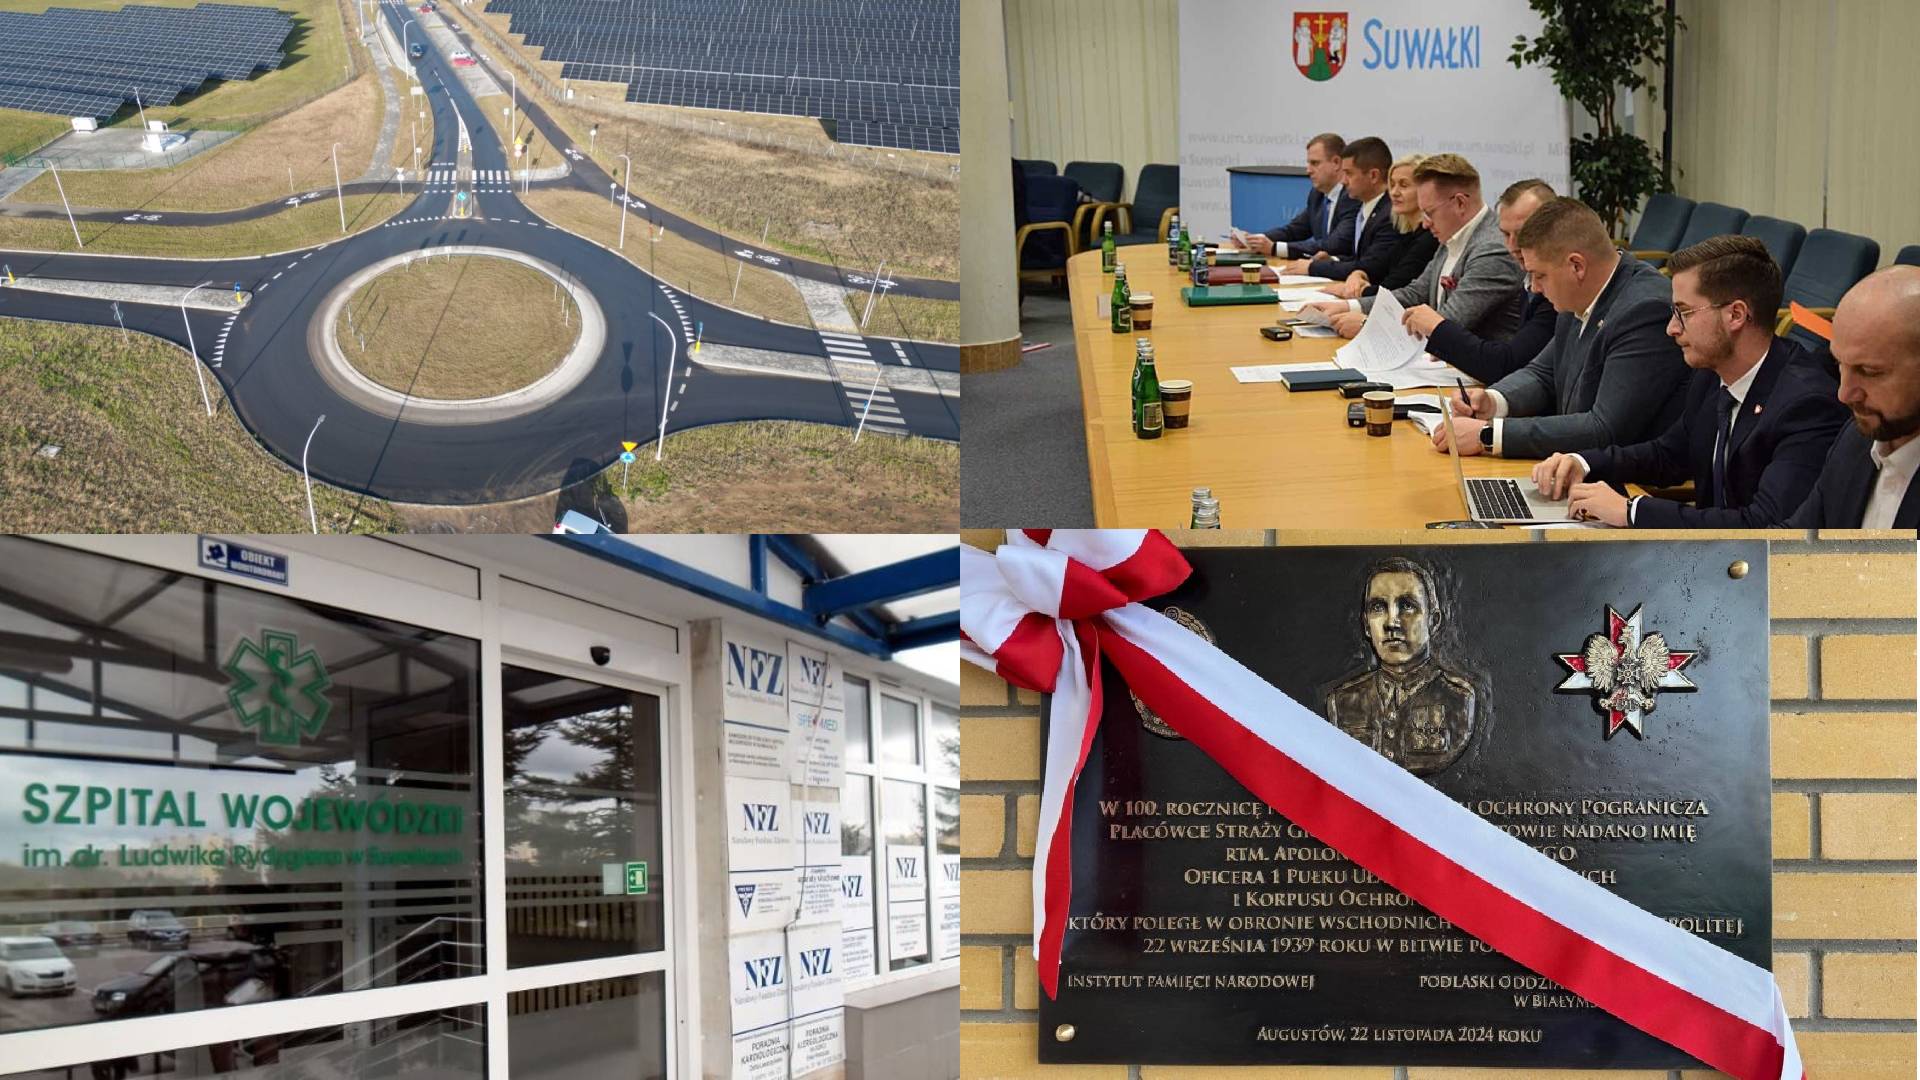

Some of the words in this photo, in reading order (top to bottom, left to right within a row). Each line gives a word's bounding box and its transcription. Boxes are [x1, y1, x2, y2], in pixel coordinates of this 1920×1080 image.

[1363, 18, 1479, 70] SUWAŁKI
[241, 549, 275, 567] OBIEKT
[727, 642, 783, 696] NFZ
[22, 783, 206, 827] SZPITAL
[222, 790, 464, 834] WOJEWÓDZKI
[1099, 801, 1120, 816] W
[1126, 800, 1160, 816] 100.
[1166, 801, 1262, 819] ROCZNICĘ
[1478, 800, 1575, 816] OCHRONY
[1582, 800, 1709, 816] POGRANICZA
[743, 804, 778, 831] NFZ
[805, 812, 831, 834] NFZ
[1110, 821, 1210, 839] PLACÓWCE
[1215, 822, 1282, 839] STRAŻY
[1563, 824, 1646, 839] NADANO
[1653, 824, 1697, 842] IMIĘ
[120, 844, 225, 866] Ludwika
[1226, 847, 1270, 861] RTM.
[896, 857, 918, 878] NFZ
[1184, 868, 1265, 884] OFICERA
[1271, 868, 1280, 884] 1
[1287, 868, 1346, 884] PUŁKU
[1246, 891, 1333, 907] KORPUSU
[1068, 912, 1129, 930] KTÓRY
[1133, 915, 1201, 930] POLEGŁ
[1207, 915, 1224, 930] W
[1229, 915, 1314, 930] OBRONIE
[1319, 915, 1452, 930] WSCHODNICH
[1143, 938, 1165, 953] 22
[1171, 937, 1265, 953] WRZEŚNIA
[1272, 938, 1314, 953] 1939
[1319, 938, 1370, 953] ROKU
[1376, 938, 1394, 953] W
[1400, 938, 1463, 953] BITWIE
[800, 947, 832, 980] NFZ
[744, 955, 783, 991] NFZ
[1420, 975, 1495, 989] PODLASKI
[1498, 974, 1565, 990] ODDZIA
[1068, 975, 1144, 988] INSTYTUT
[1147, 975, 1211, 990] PAMIĘCI
[1216, 975, 1315, 990] NARODOWEJ
[1513, 994, 1528, 1008] W
[1257, 1024, 1346, 1041] AUGUSTÓW,
[1350, 1026, 1369, 1041] 22
[1374, 1026, 1454, 1042] LISTOPADA
[1458, 1026, 1494, 1042] 2024
[1498, 1028, 1544, 1043] ROKU
